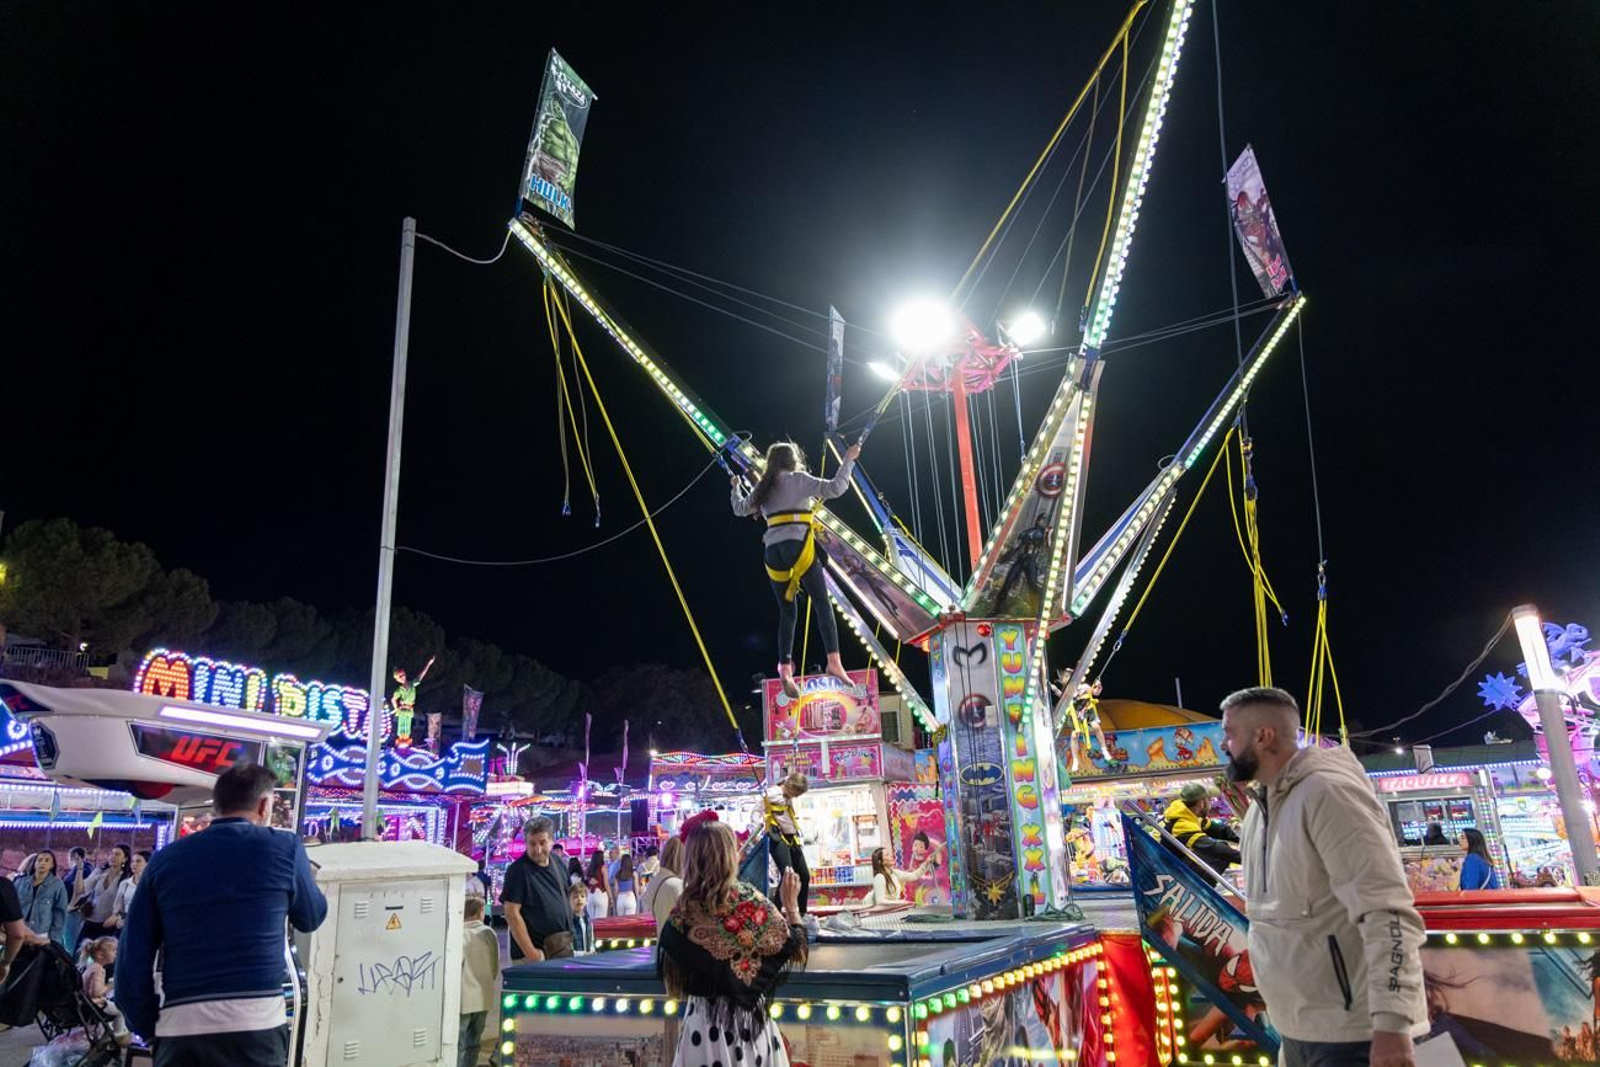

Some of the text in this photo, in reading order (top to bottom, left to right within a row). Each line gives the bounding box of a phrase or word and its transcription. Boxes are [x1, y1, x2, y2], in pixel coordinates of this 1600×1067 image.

[529, 174, 572, 211] HULK
[139, 652, 264, 713] MINI
[170, 736, 242, 767] UFC
[1385, 775, 1467, 789] TAQUILLA
[1020, 822, 1046, 905] XXL
[1143, 874, 1233, 956] SALIDA
